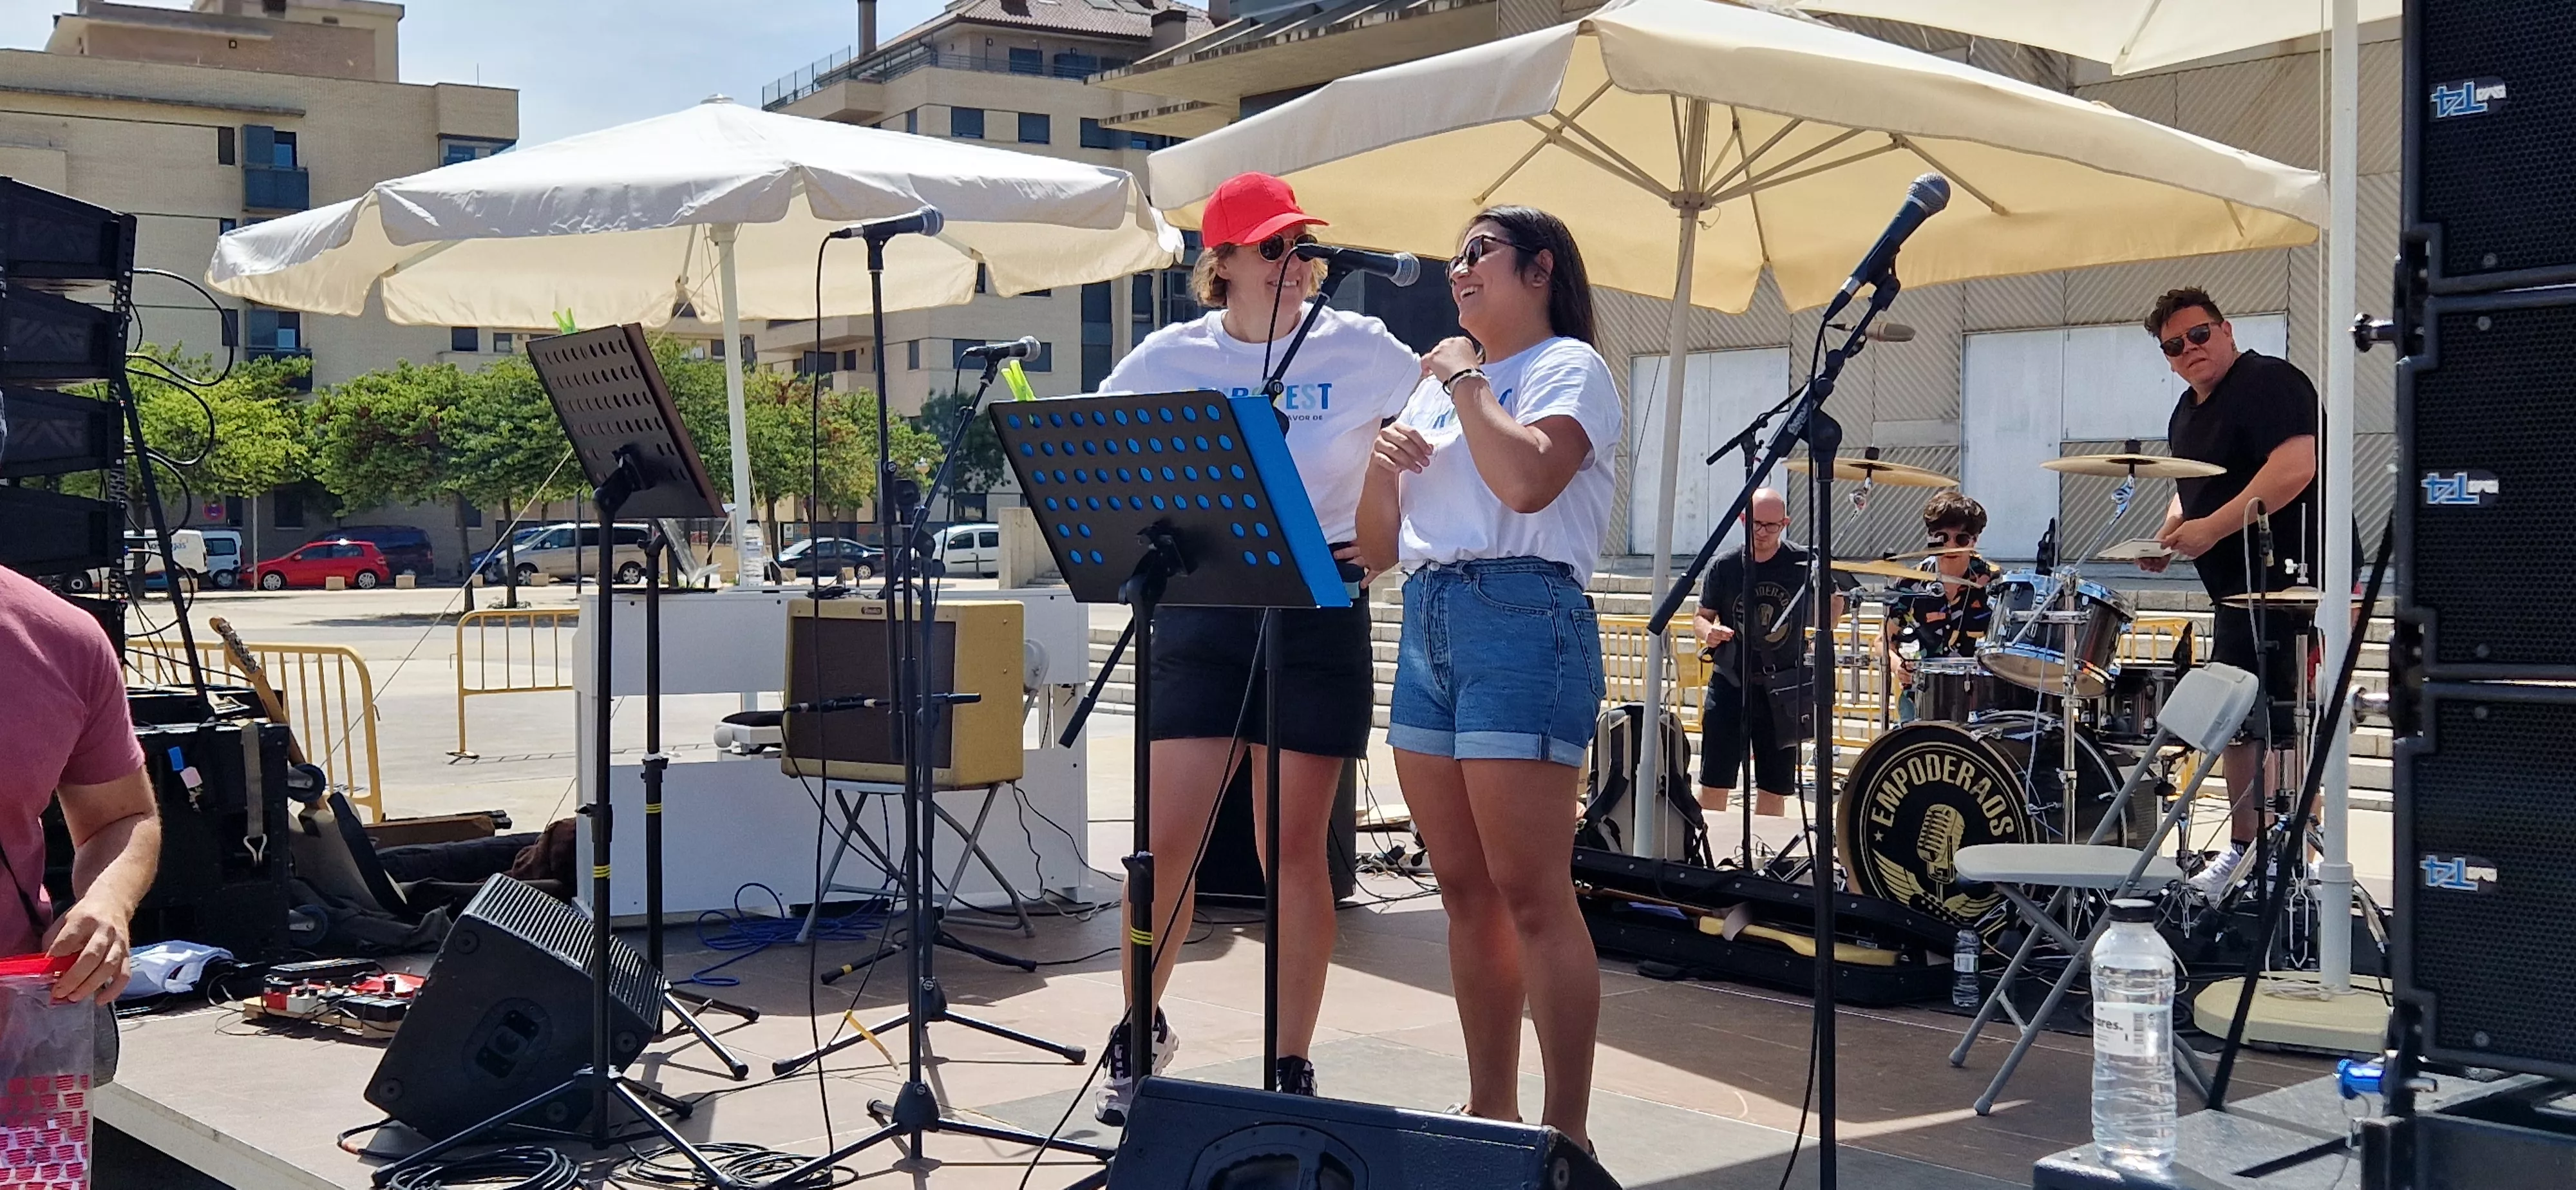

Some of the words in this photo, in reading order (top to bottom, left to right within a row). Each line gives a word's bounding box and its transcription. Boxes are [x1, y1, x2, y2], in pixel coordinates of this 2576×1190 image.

[2430, 81, 2488, 118] T4
[2421, 471, 2480, 505] T4
[1871, 753, 2014, 836] EMPODERAOS
[2420, 854, 2479, 891] T4
